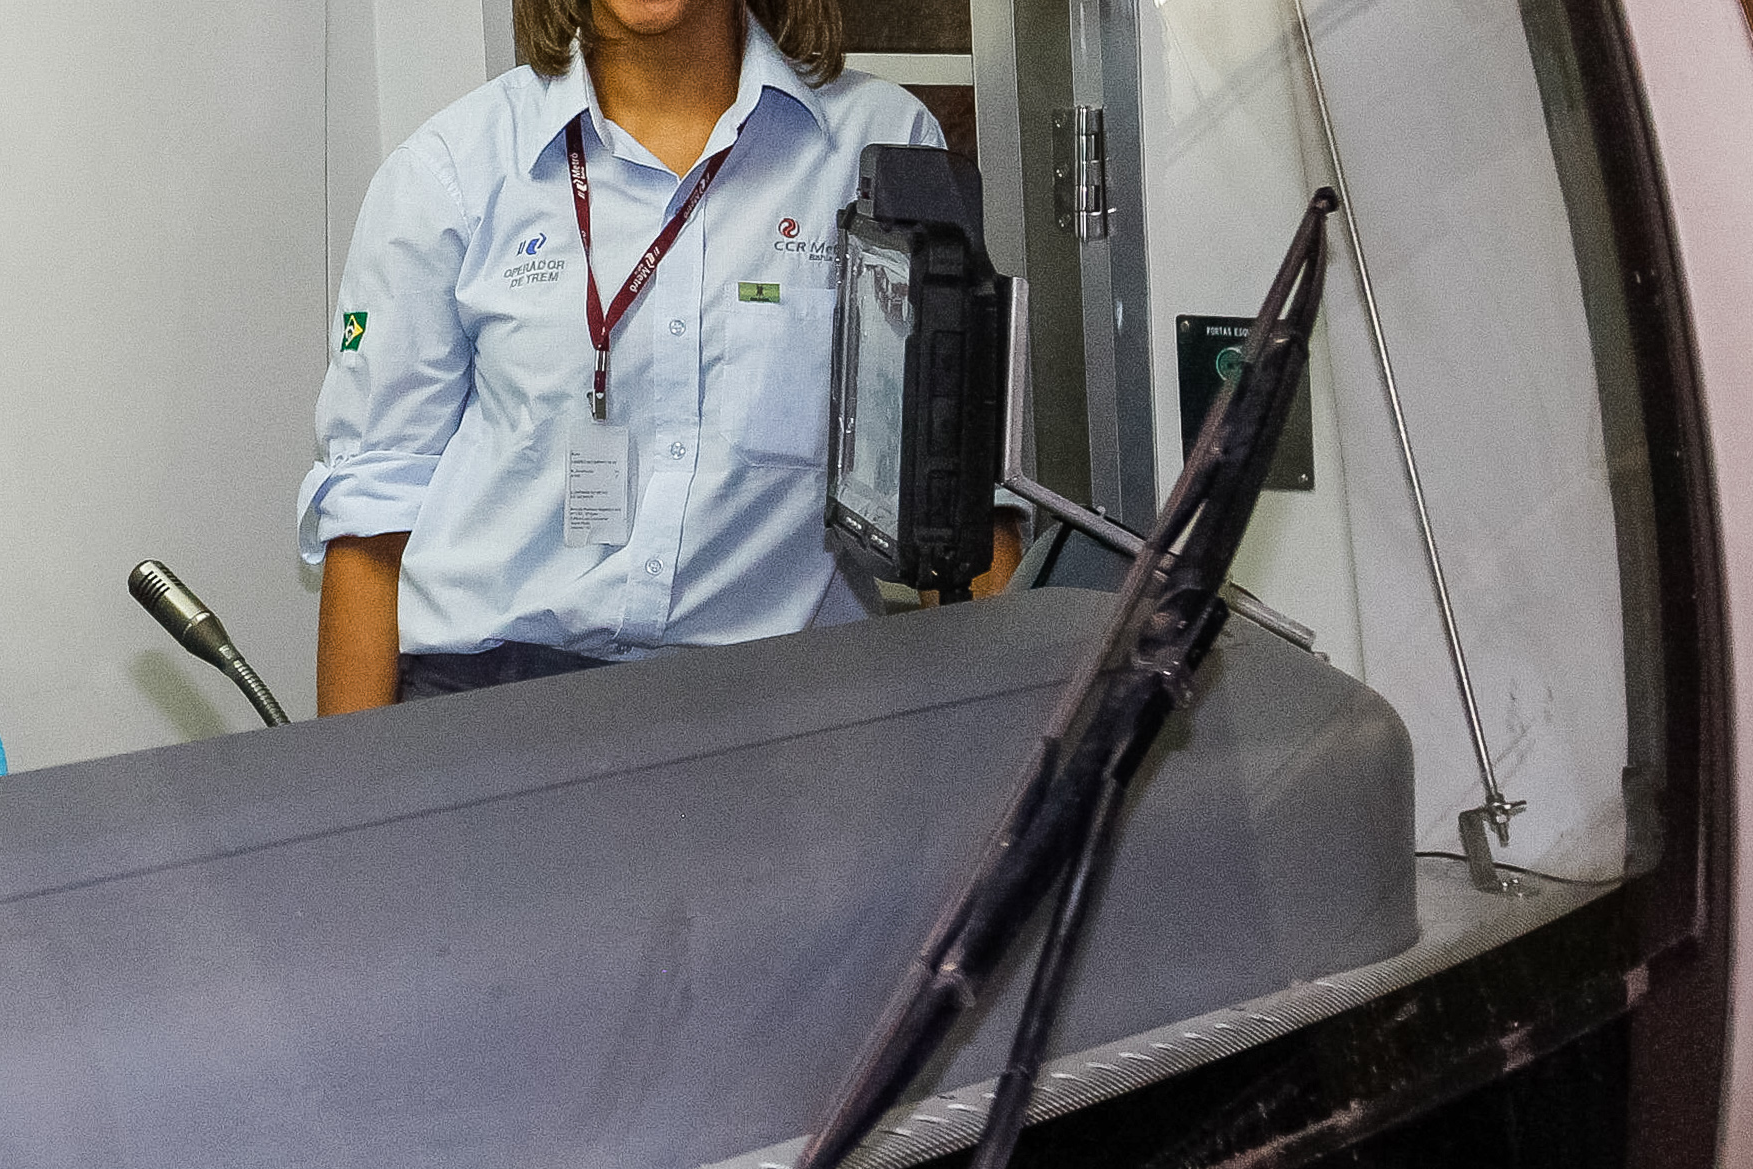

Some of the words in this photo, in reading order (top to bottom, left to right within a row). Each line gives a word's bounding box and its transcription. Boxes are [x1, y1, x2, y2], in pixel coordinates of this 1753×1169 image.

[774, 240, 807, 252] CCR
[503, 259, 565, 279] OPERADOR
[509, 276, 524, 289] DE
[526, 271, 559, 284] TREM
